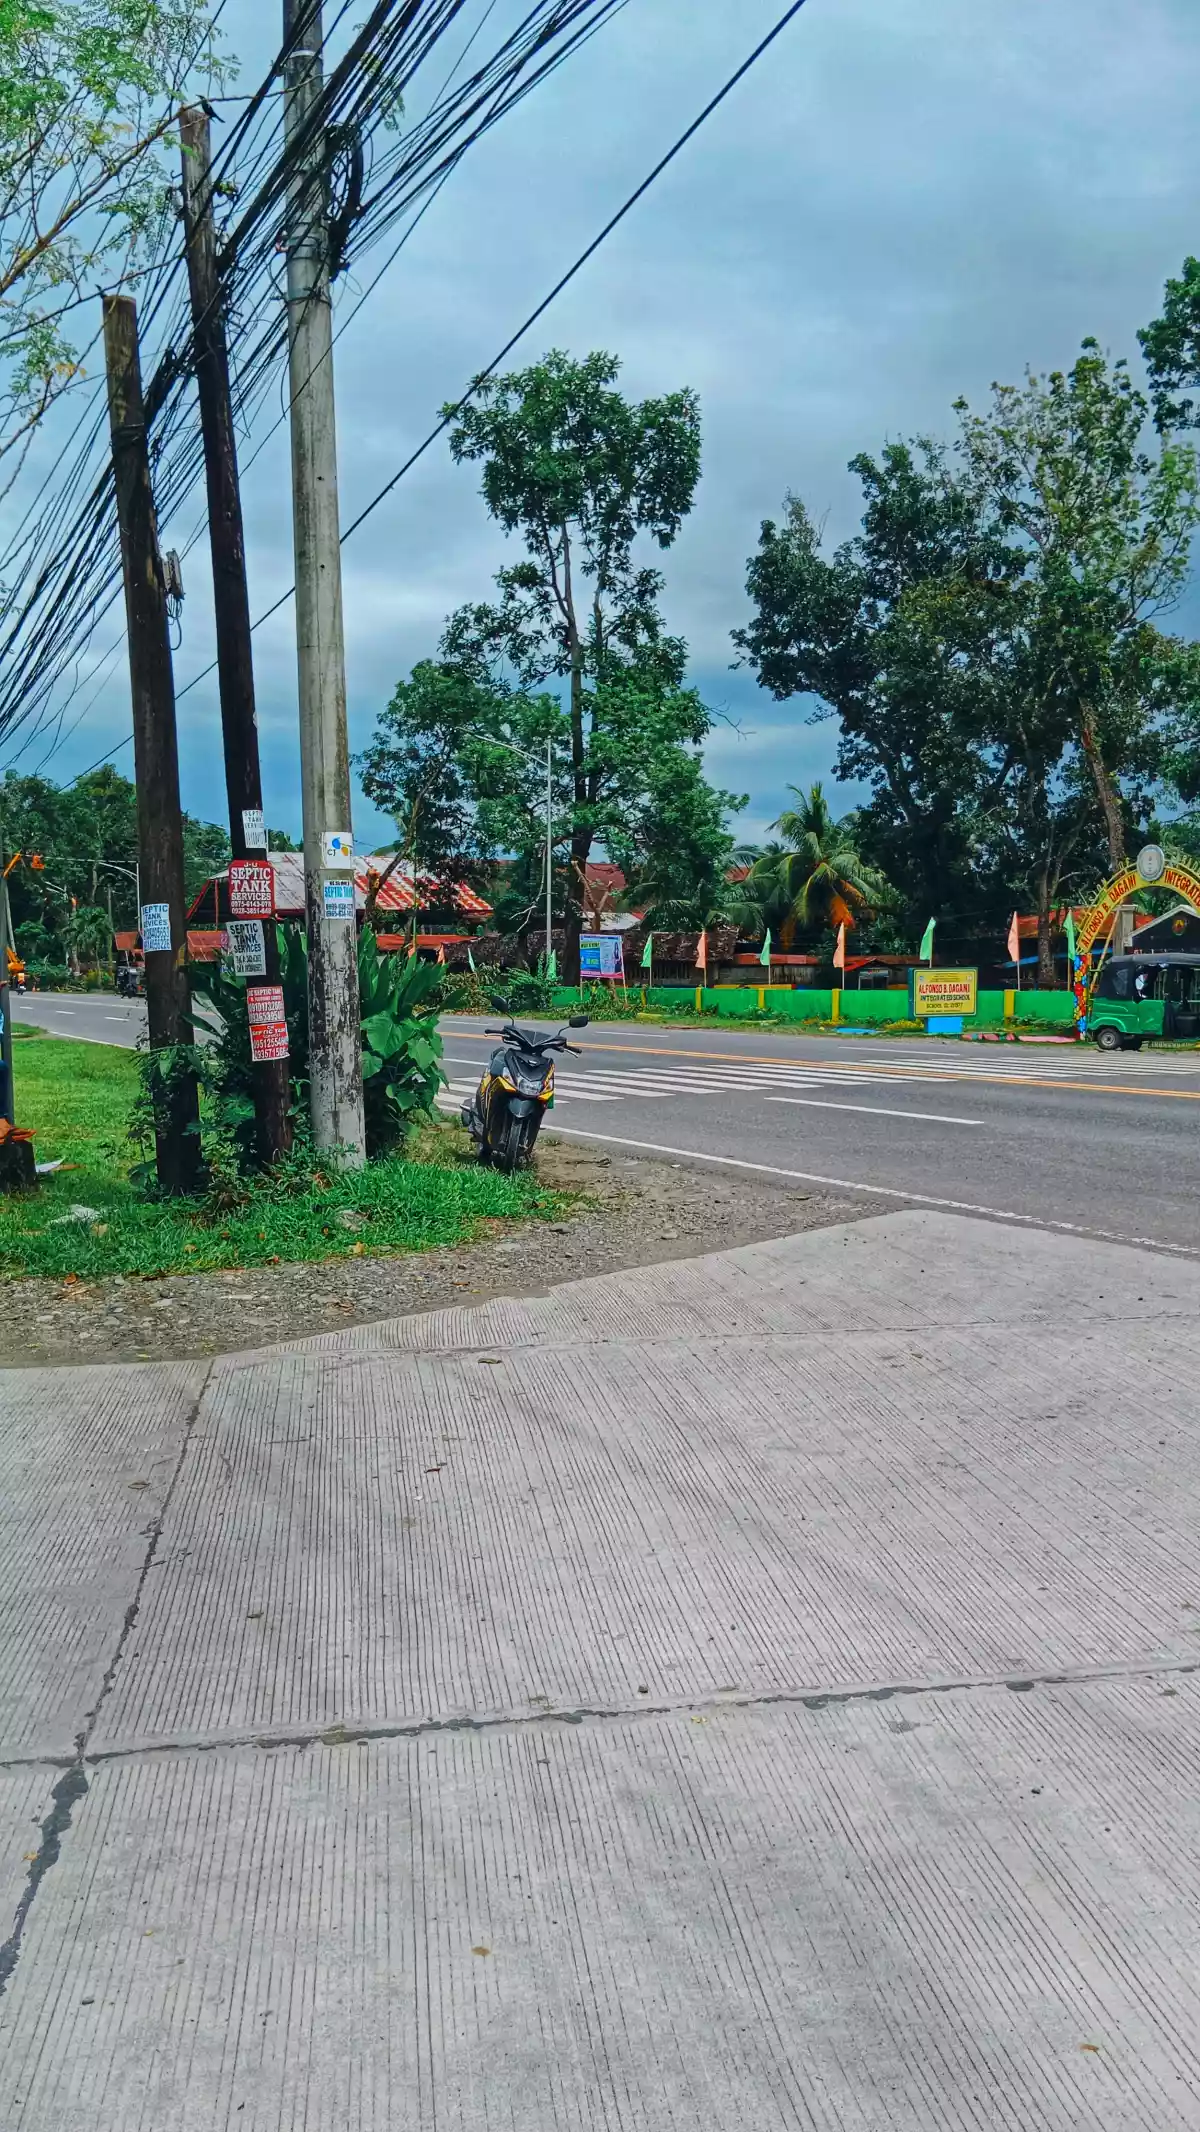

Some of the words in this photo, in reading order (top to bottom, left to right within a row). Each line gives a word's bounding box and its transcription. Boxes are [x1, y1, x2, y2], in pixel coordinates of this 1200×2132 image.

[231, 867, 271, 880] SEPTIC
[231, 880, 272, 892] TANK
[231, 892, 272, 901] SERVICES
[144, 912, 162, 921] TANK
[1080, 910, 1104, 949] ALFONSO
[1108, 874, 1137, 901] DAGANI
[230, 922, 259, 935] SEPTIC
[234, 933, 258, 945] TANK
[919, 984, 943, 994] ALFONSO
[949, 984, 970, 993] DAGANI
